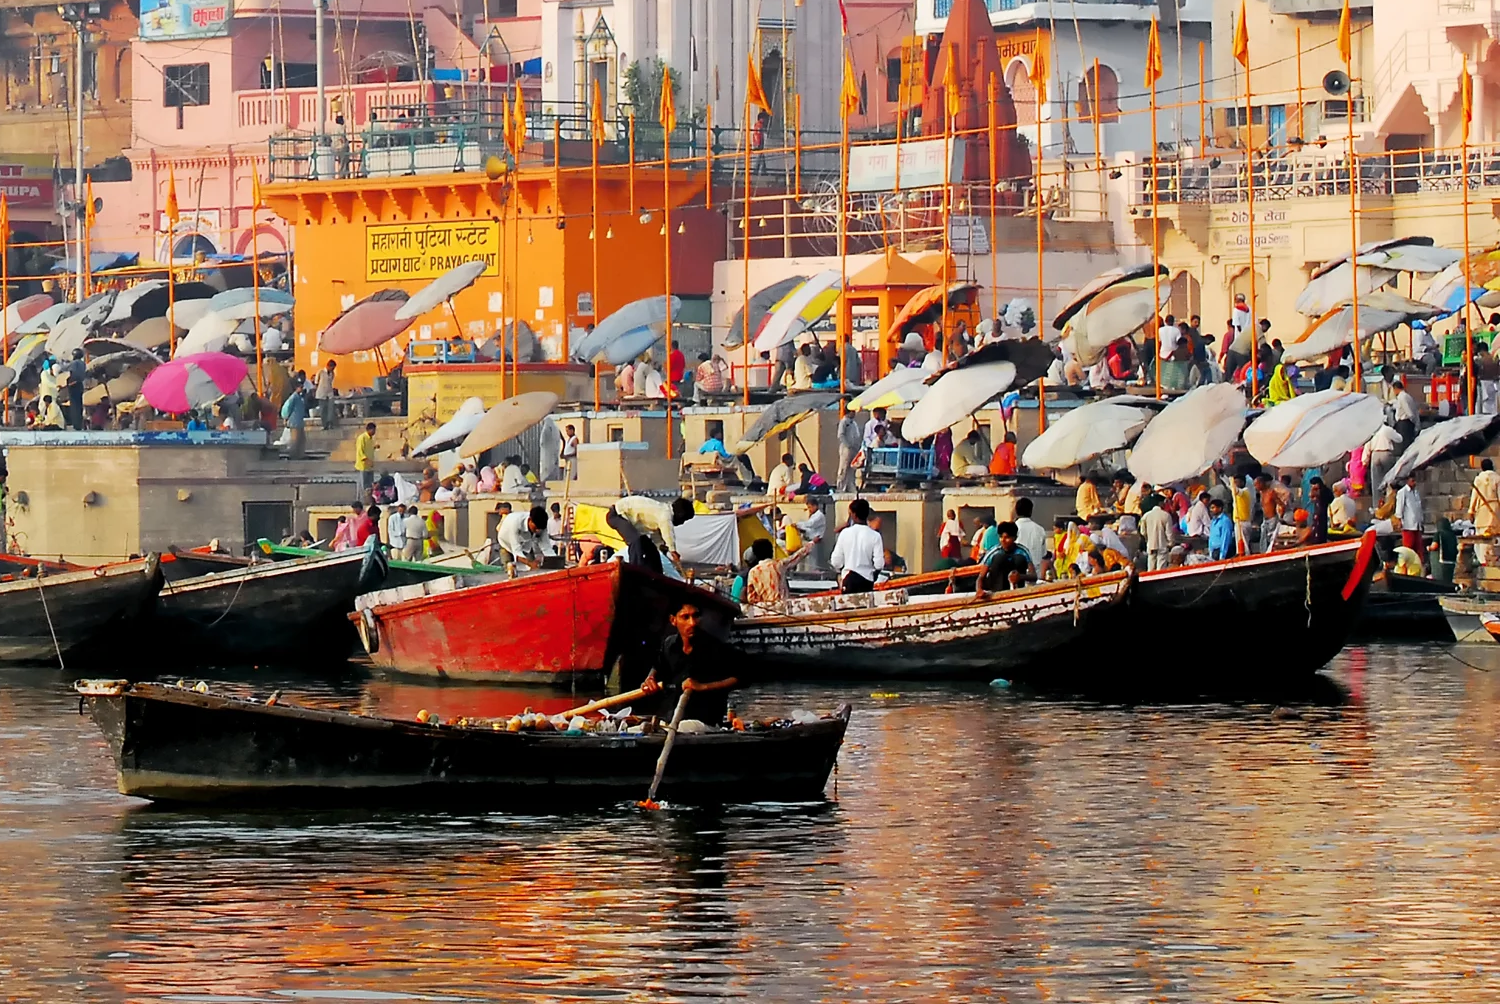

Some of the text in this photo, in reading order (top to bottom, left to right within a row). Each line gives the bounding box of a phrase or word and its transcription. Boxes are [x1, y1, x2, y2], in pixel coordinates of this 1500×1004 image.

[1236, 234, 1268, 248] Gaga
[371, 258, 401, 275] प्रयाग
[402, 257, 421, 273] घाट
